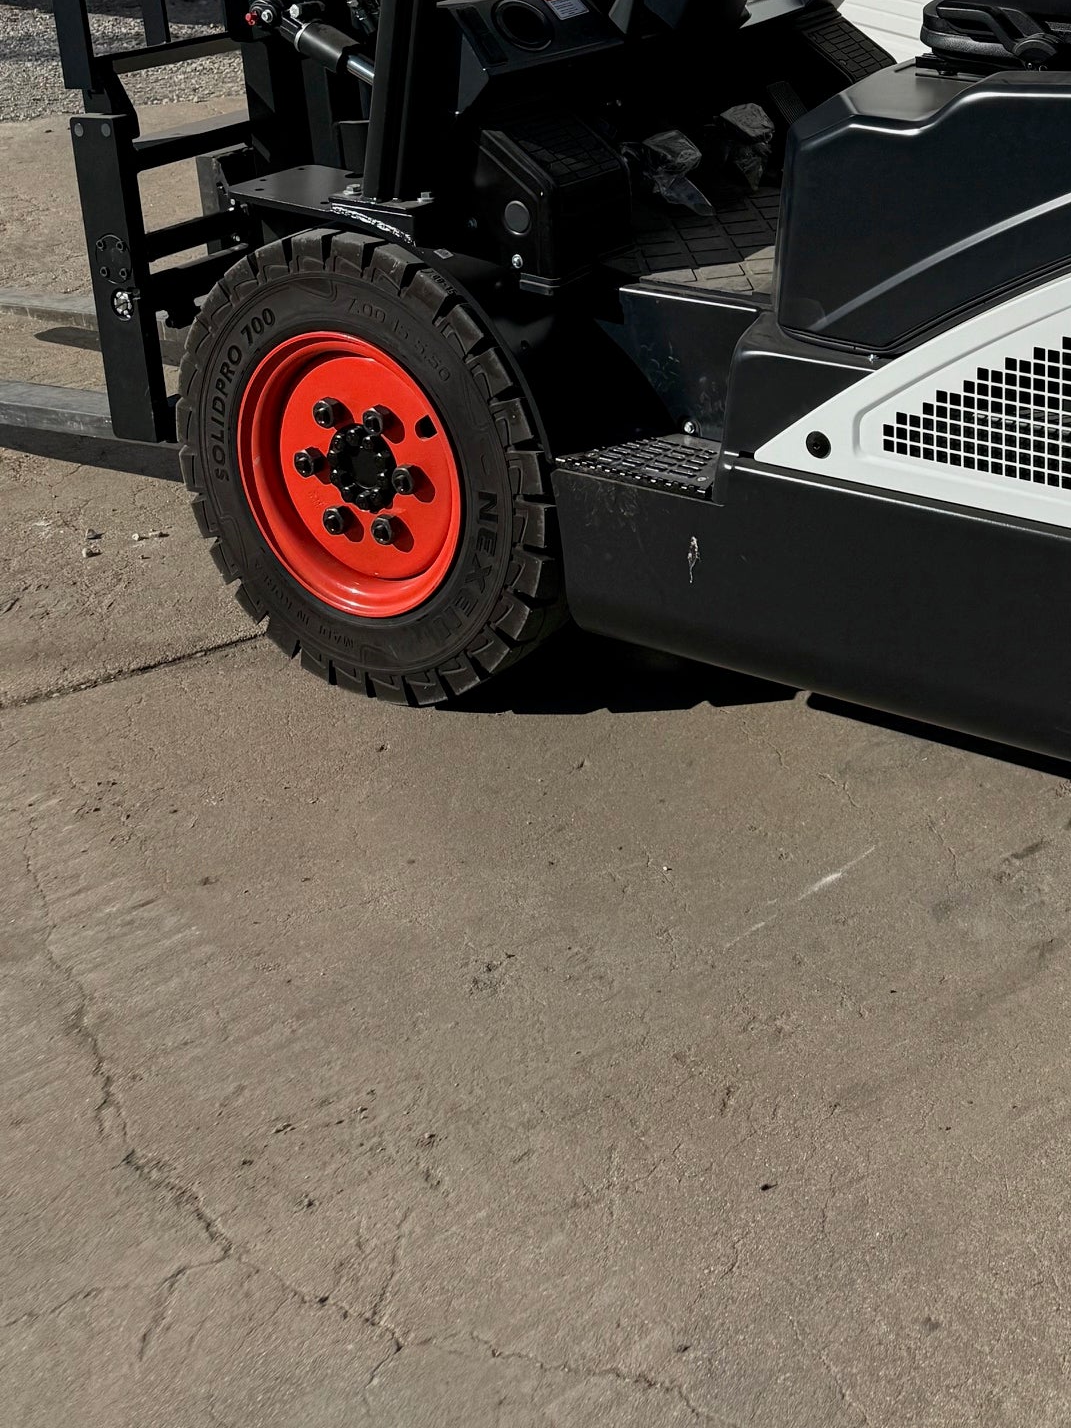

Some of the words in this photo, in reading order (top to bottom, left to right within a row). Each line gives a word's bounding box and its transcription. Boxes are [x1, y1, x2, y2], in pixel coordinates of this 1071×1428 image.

[211, 344, 243, 481] SOLIDPRO
[241, 307, 276, 344] 700
[432, 491, 499, 642] NEXEN
